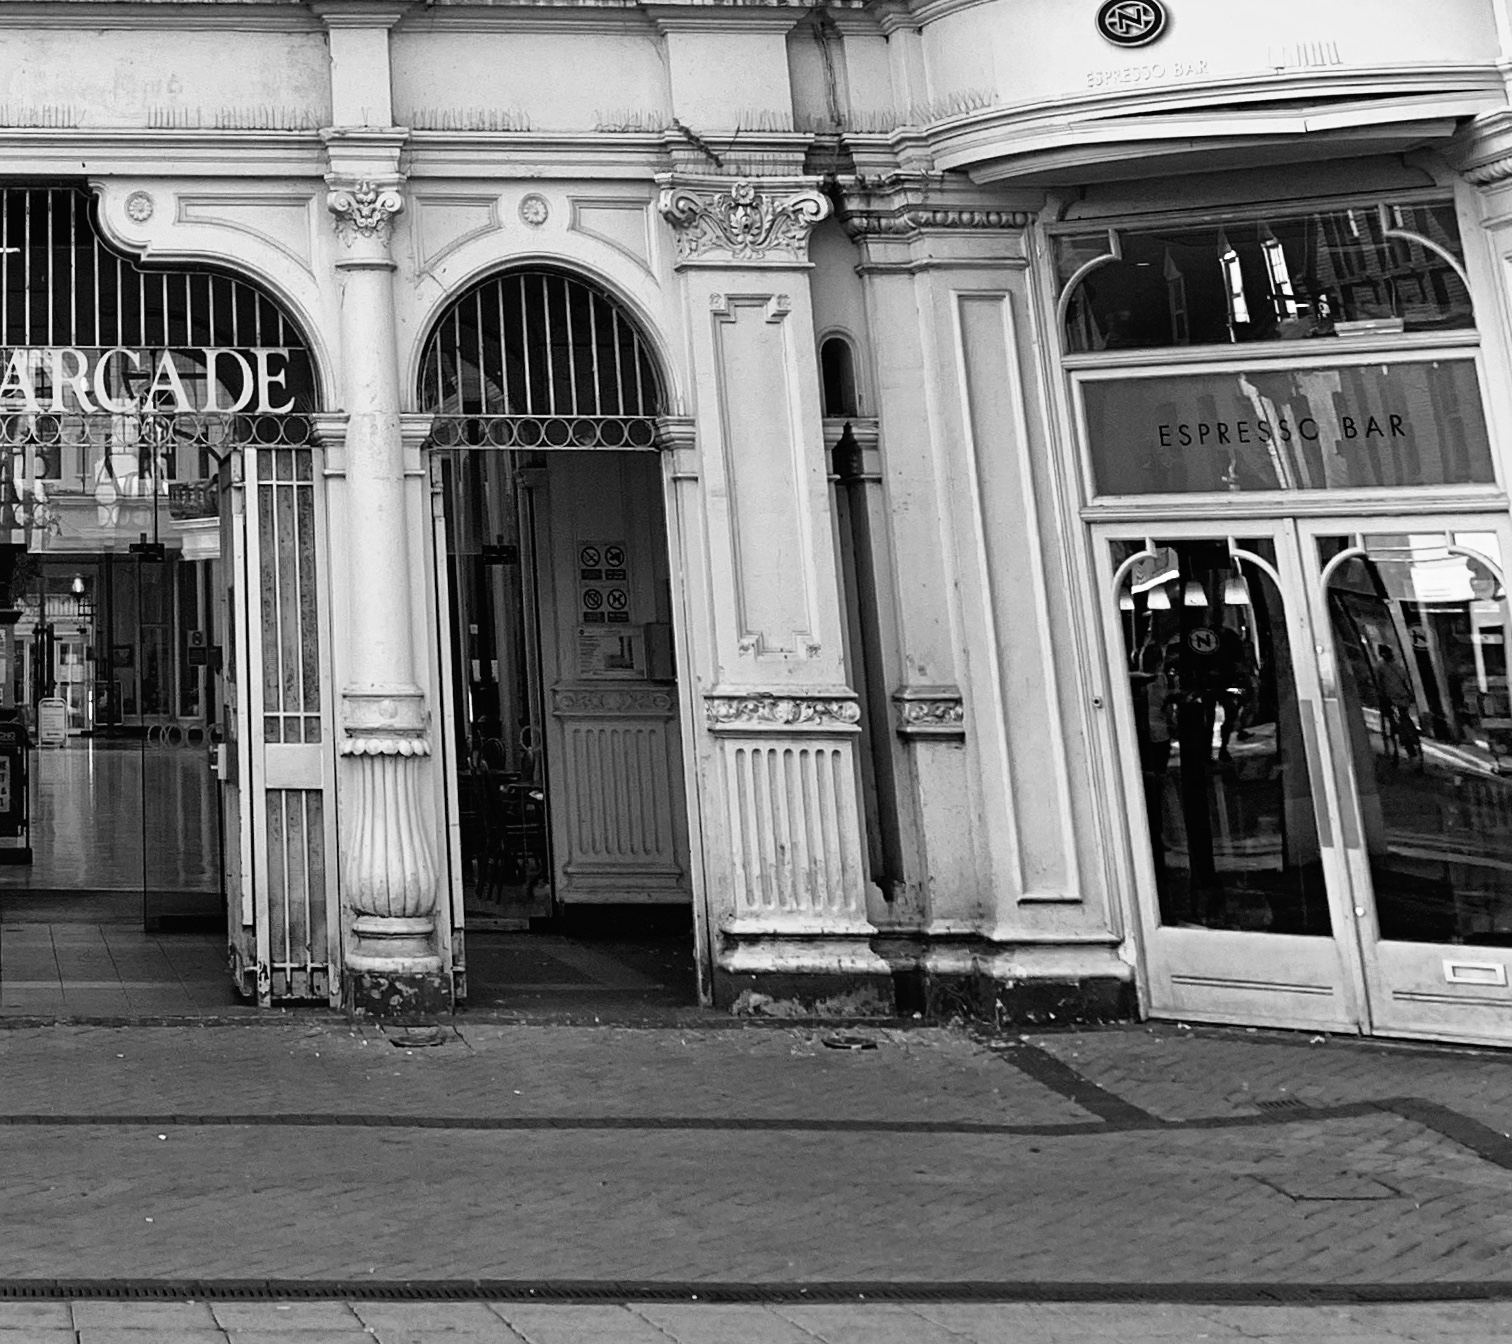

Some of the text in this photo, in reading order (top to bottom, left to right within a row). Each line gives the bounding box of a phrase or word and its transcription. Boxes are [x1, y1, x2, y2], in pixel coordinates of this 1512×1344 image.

[1085, 60, 1209, 88] ESPRESSO BAR
[1158, 412, 1408, 448] ESPRESSO BAR
